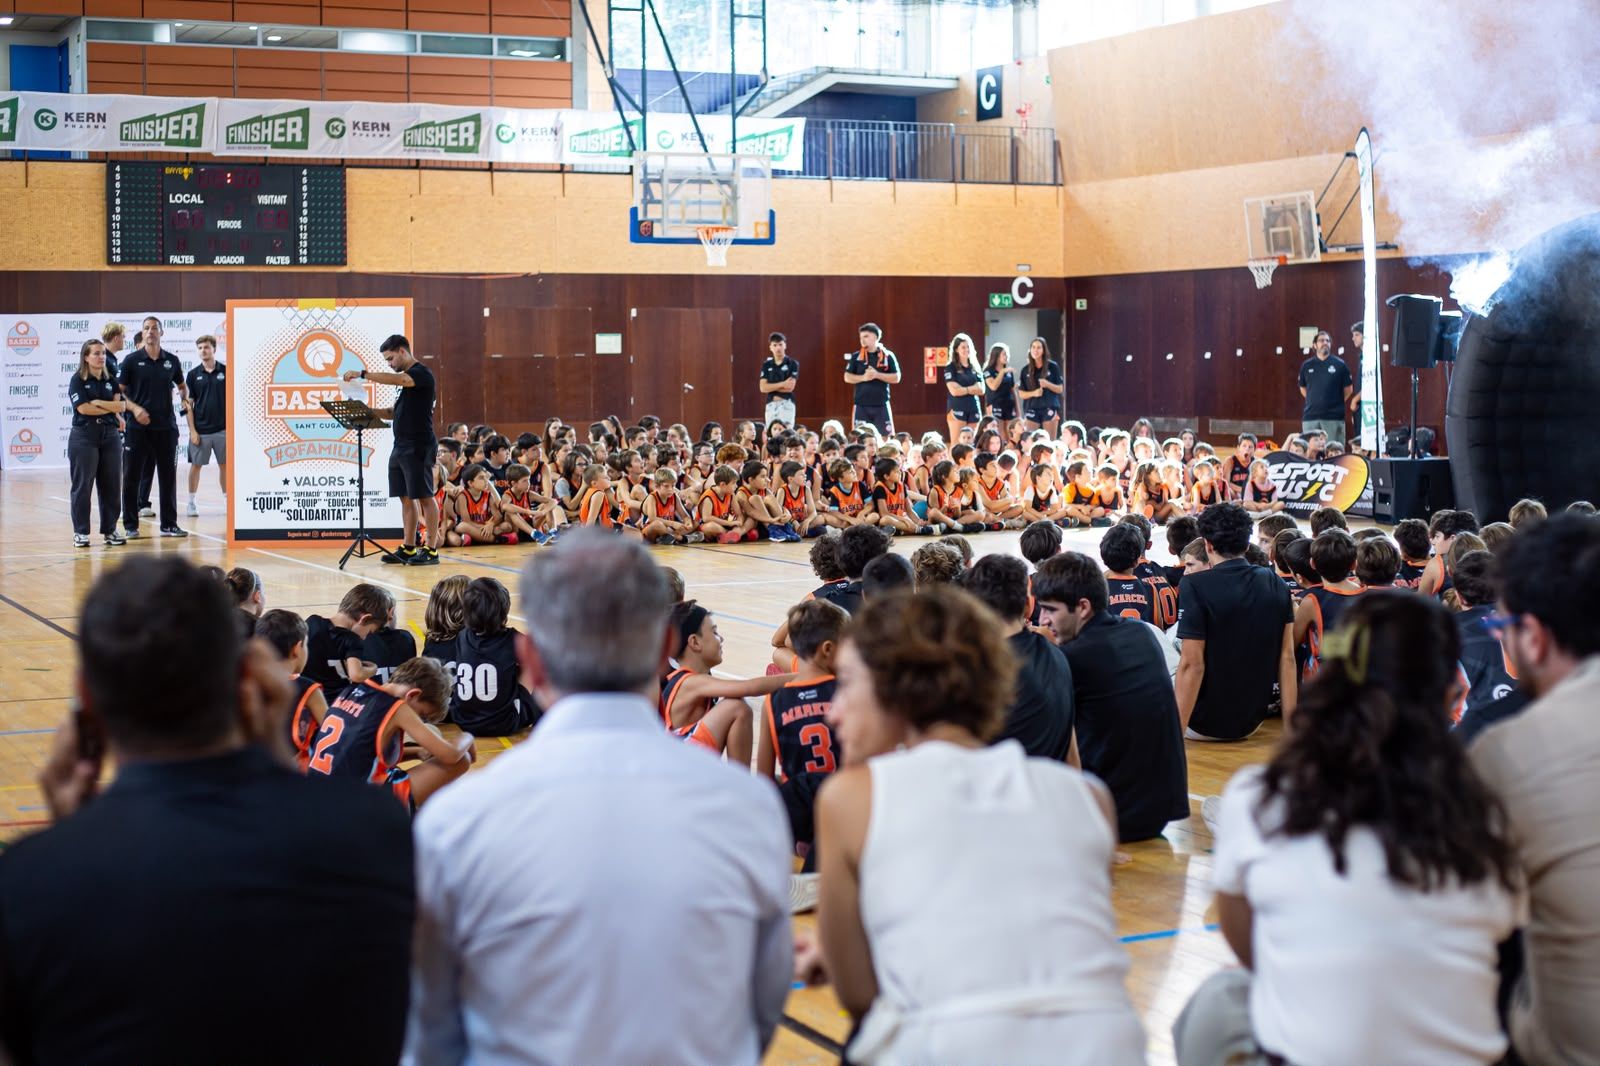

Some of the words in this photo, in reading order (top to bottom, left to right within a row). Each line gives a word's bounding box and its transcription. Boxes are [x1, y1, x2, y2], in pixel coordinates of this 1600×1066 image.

[980, 74, 997, 110] C
[64, 112, 107, 123] KERN
[122, 112, 199, 140] FINISHER
[228, 116, 304, 145] FINISHER
[352, 120, 391, 132] KERN
[404, 121, 475, 148] FINISHER
[521, 127, 558, 136] KERN
[681, 132, 714, 142] KEN
[169, 193, 204, 204] LOCAL
[257, 195, 288, 205] VISITANT
[302, 200, 308, 208] 8
[302, 208, 308, 216] 9
[217, 220, 242, 229] PERIODE
[299, 216, 308, 224] 10
[112, 222, 121, 230] 11
[299, 224, 308, 232] 11
[299, 232, 308, 240] 12
[299, 240, 308, 248] 13
[299, 248, 308, 256] 14
[112, 255, 121, 263] 15
[169, 255, 195, 264] FALTES
[213, 256, 245, 264] JUGADOR
[265, 256, 291, 264] FALTES
[299, 256, 308, 264] 15
[1011, 276, 1034, 305] C
[60, 320, 89, 329] FINISHER
[164, 320, 193, 329] FINISHER
[9, 338, 38, 346] BASKET
[9, 385, 39, 396] FINISHER
[11, 446, 41, 454] BASKET
[294, 476, 346, 487] VALORS
[457, 663, 498, 702] 30
[309, 714, 345, 775] 2
[800, 725, 836, 773] 3
